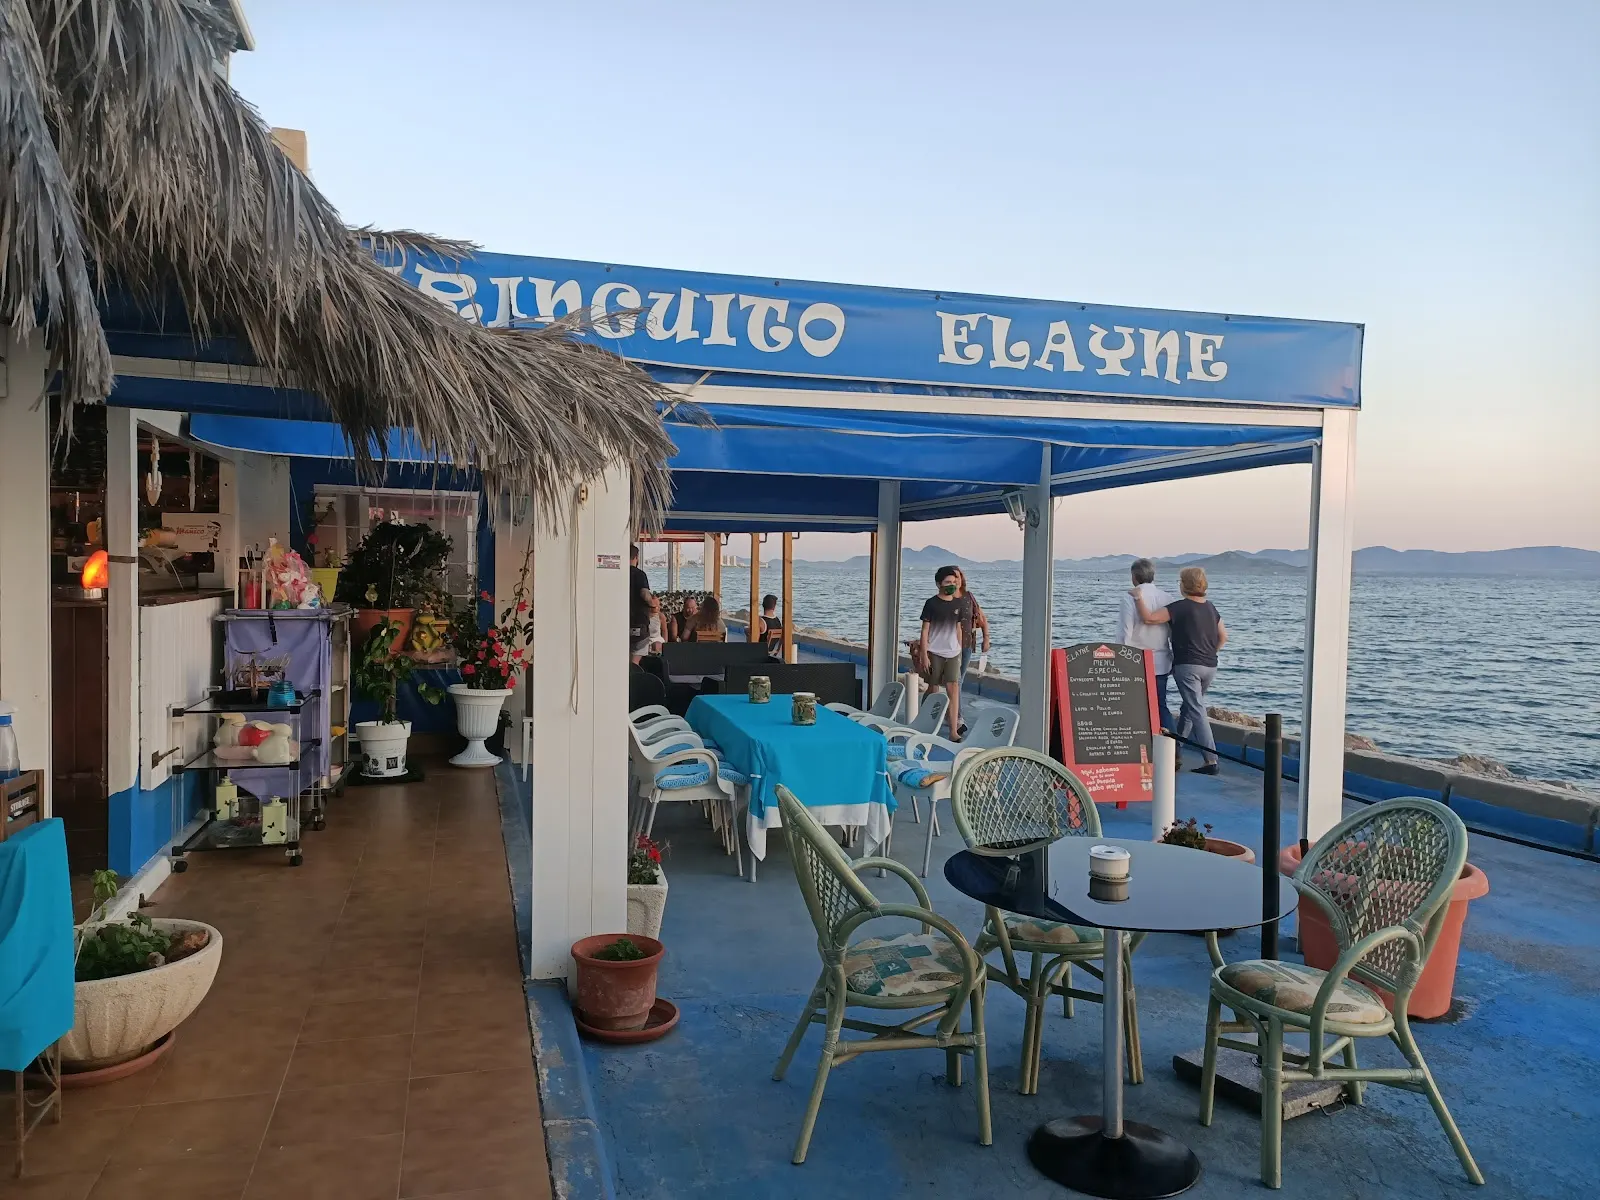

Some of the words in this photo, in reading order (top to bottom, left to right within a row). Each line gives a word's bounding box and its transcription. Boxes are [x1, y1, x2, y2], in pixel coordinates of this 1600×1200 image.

[384, 262, 846, 358] RINGUITO
[935, 310, 1229, 385] ELAYNE
[1067, 645, 1090, 662] ELAYNE
[1119, 645, 1142, 664] BBQ
